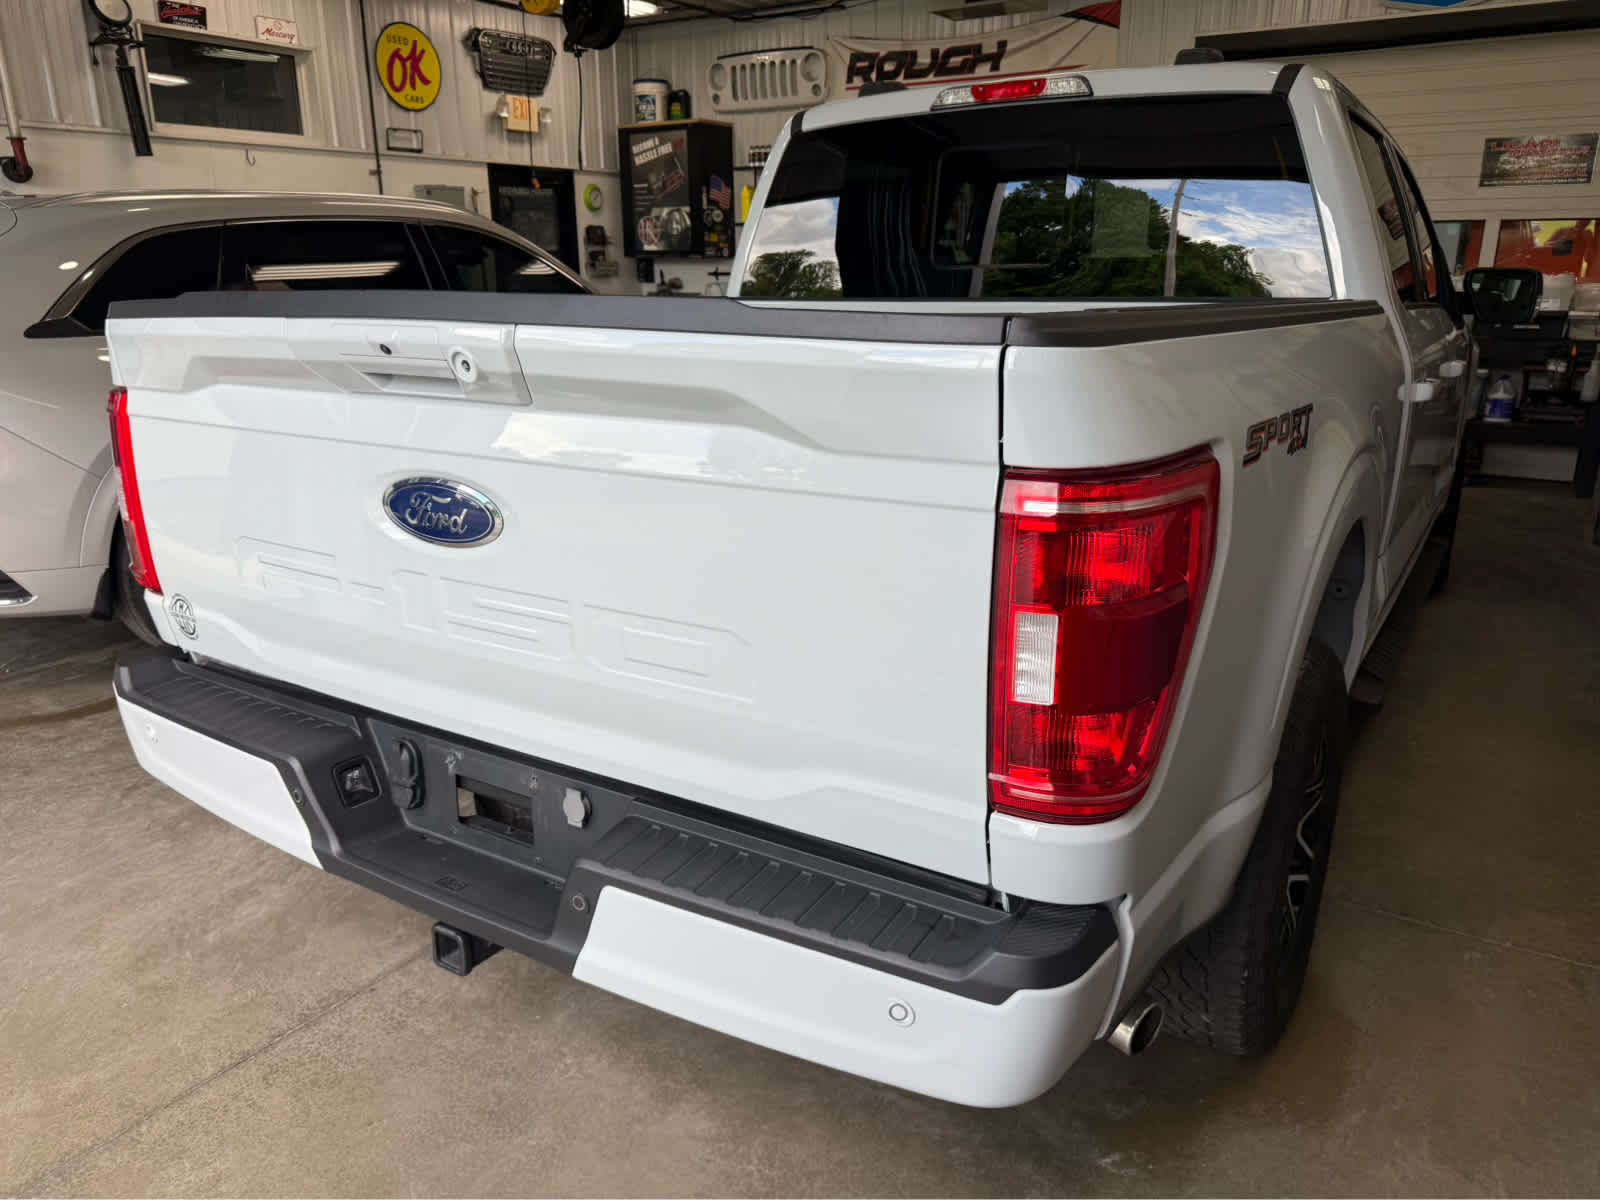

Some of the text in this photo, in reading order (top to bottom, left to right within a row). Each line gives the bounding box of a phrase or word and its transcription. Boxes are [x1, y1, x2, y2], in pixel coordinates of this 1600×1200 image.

[261, 27, 296, 44] Mercury
[386, 33, 409, 46] USED
[387, 39, 432, 93] OK
[845, 40, 1008, 84] ROUGH
[404, 94, 425, 104] CARS
[1242, 402, 1314, 467] SPORT
[404, 490, 469, 535] Ford
[235, 534, 755, 704] F-150
